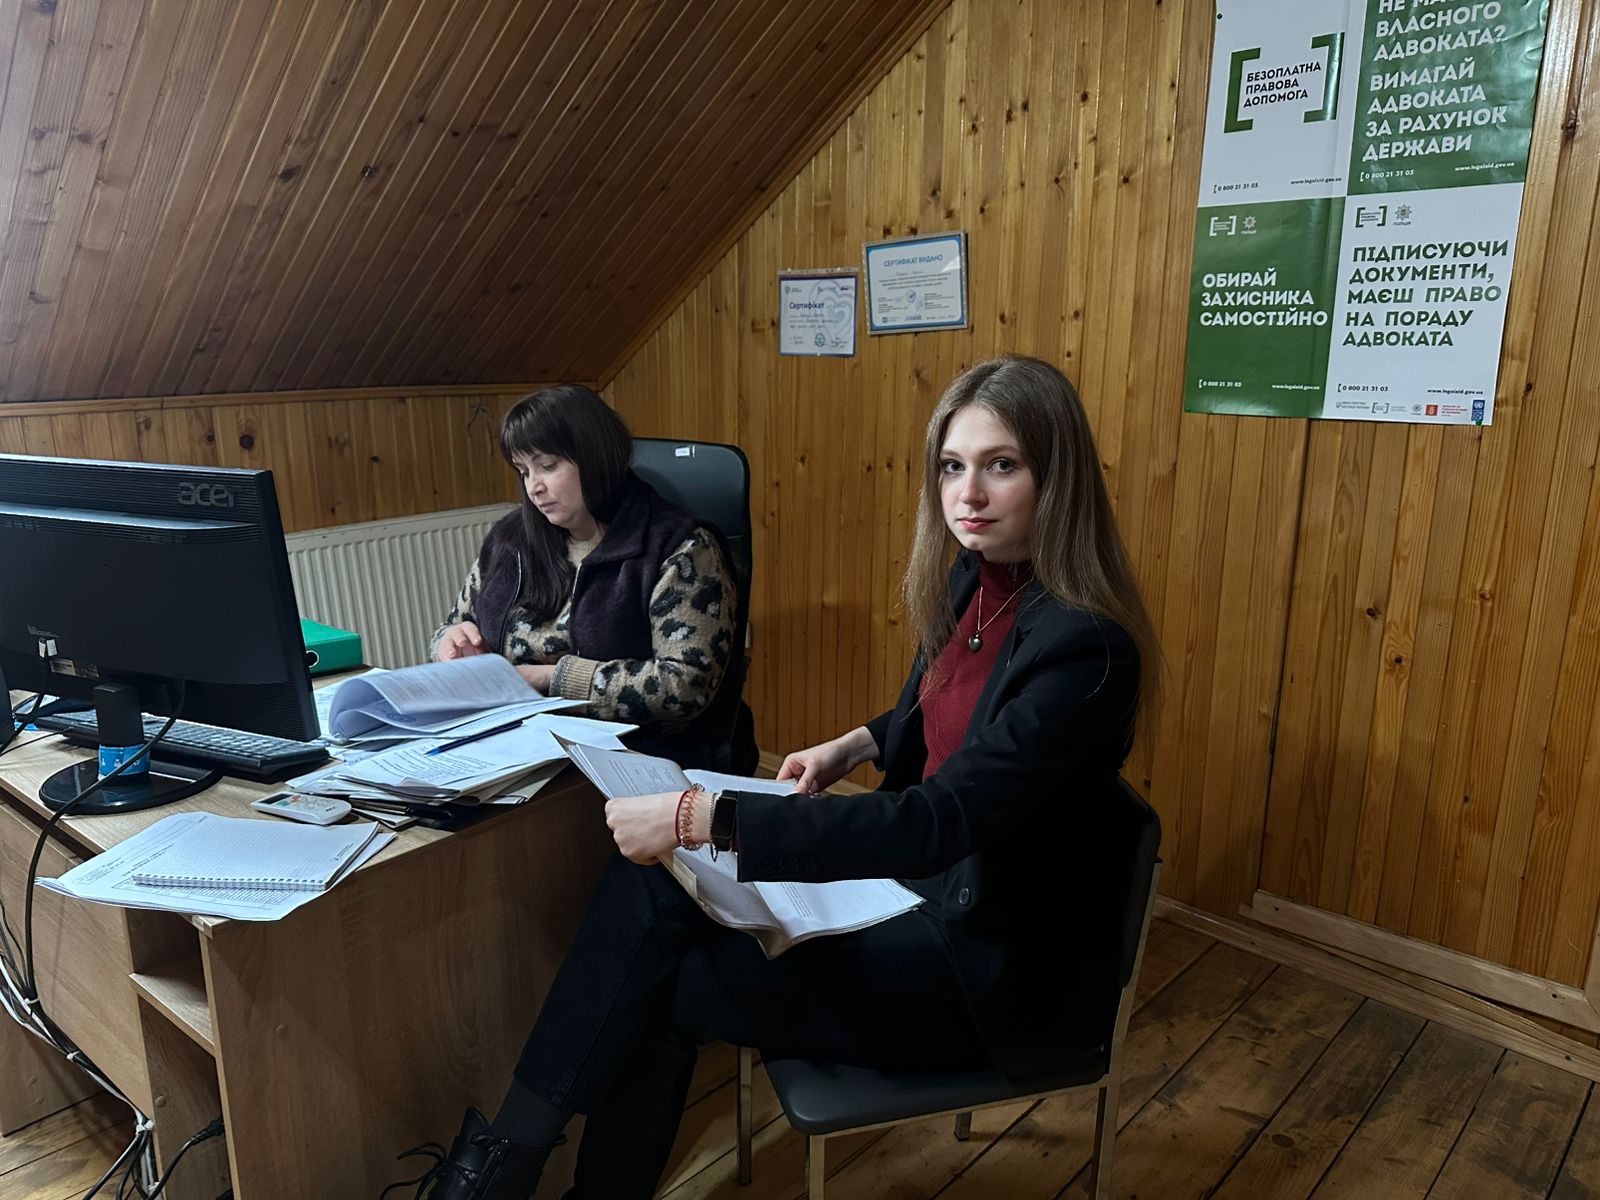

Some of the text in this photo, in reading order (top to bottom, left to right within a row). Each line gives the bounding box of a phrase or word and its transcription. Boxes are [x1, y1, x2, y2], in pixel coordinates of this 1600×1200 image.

[1378, 0, 1405, 14] НЕ
[1375, 2, 1501, 37] ВЛАСНОГО
[1373, 25, 1506, 61] АДВОКАТА?
[1247, 61, 1321, 82] БЕЗОПЛАТНА
[1370, 57, 1475, 91] ВИМАГАЙ
[1246, 78, 1299, 95] ПРАВОВА
[1243, 89, 1308, 108] ДОПОМОГА
[1367, 84, 1486, 115] АДВОКАТА
[1365, 106, 1507, 137] ЗА РАХУНОК
[1362, 134, 1472, 162] ДЕРЖАВИ
[1371, 171, 1385, 179] 800
[1385, 170, 1393, 178] 21
[883, 254, 944, 268] СЕРТИФІКАТ ВИДАНО
[1352, 240, 1508, 263] ПІДПИСУЮЧИ
[1202, 267, 1277, 288] ОБИРАЙ
[1349, 262, 1494, 285] ДОКУМЕНТИ,
[1201, 290, 1314, 307] ЗАХИСНИКА
[1347, 285, 1502, 304] МАЄШ ПРАВО
[789, 301, 825, 311] Сертифікат
[1199, 306, 1329, 326] САМОСТІЙНО
[1345, 310, 1474, 327] НА ПОРАДУ
[1342, 331, 1454, 347] АДВОКАТА
[177, 482, 239, 507] acer
